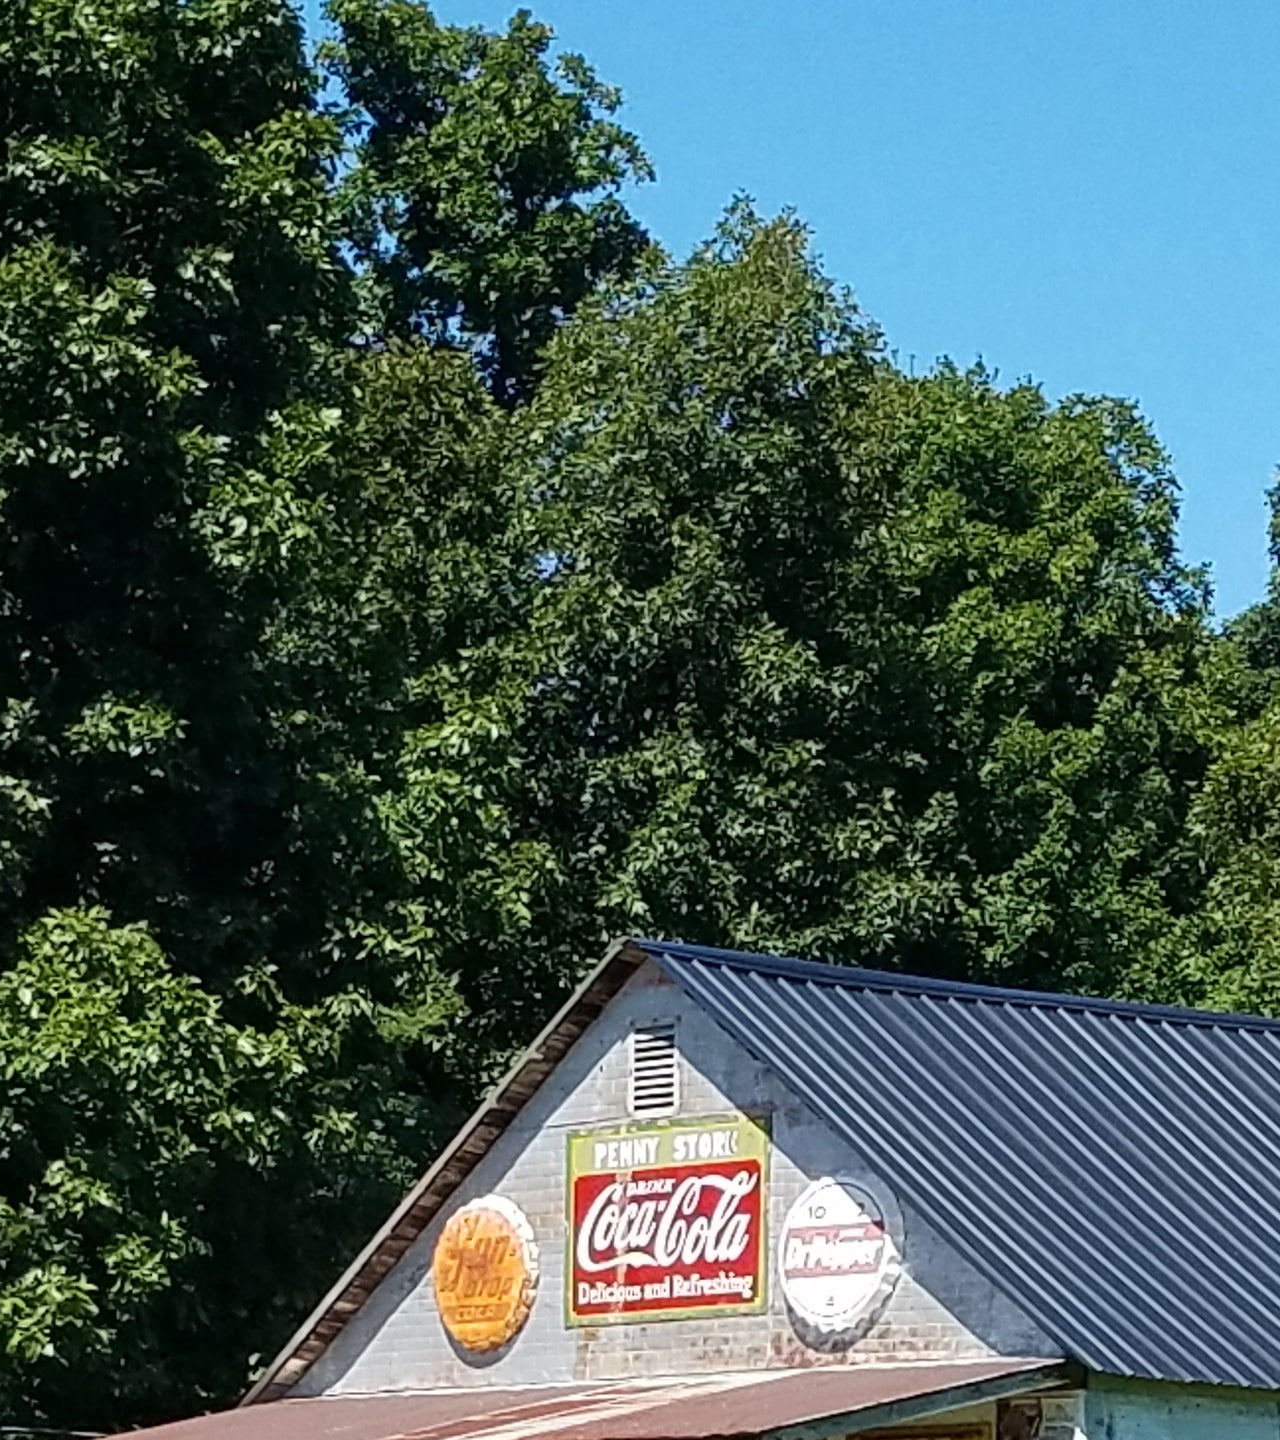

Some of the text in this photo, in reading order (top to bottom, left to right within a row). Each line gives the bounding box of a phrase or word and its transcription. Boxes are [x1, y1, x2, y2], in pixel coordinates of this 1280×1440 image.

[595, 1137, 659, 1168] PENNY
[577, 1170, 759, 1272] Coca-Cola
[808, 1206, 826, 1219] 10
[578, 1271, 753, 1304] Delicious and Refreshing
